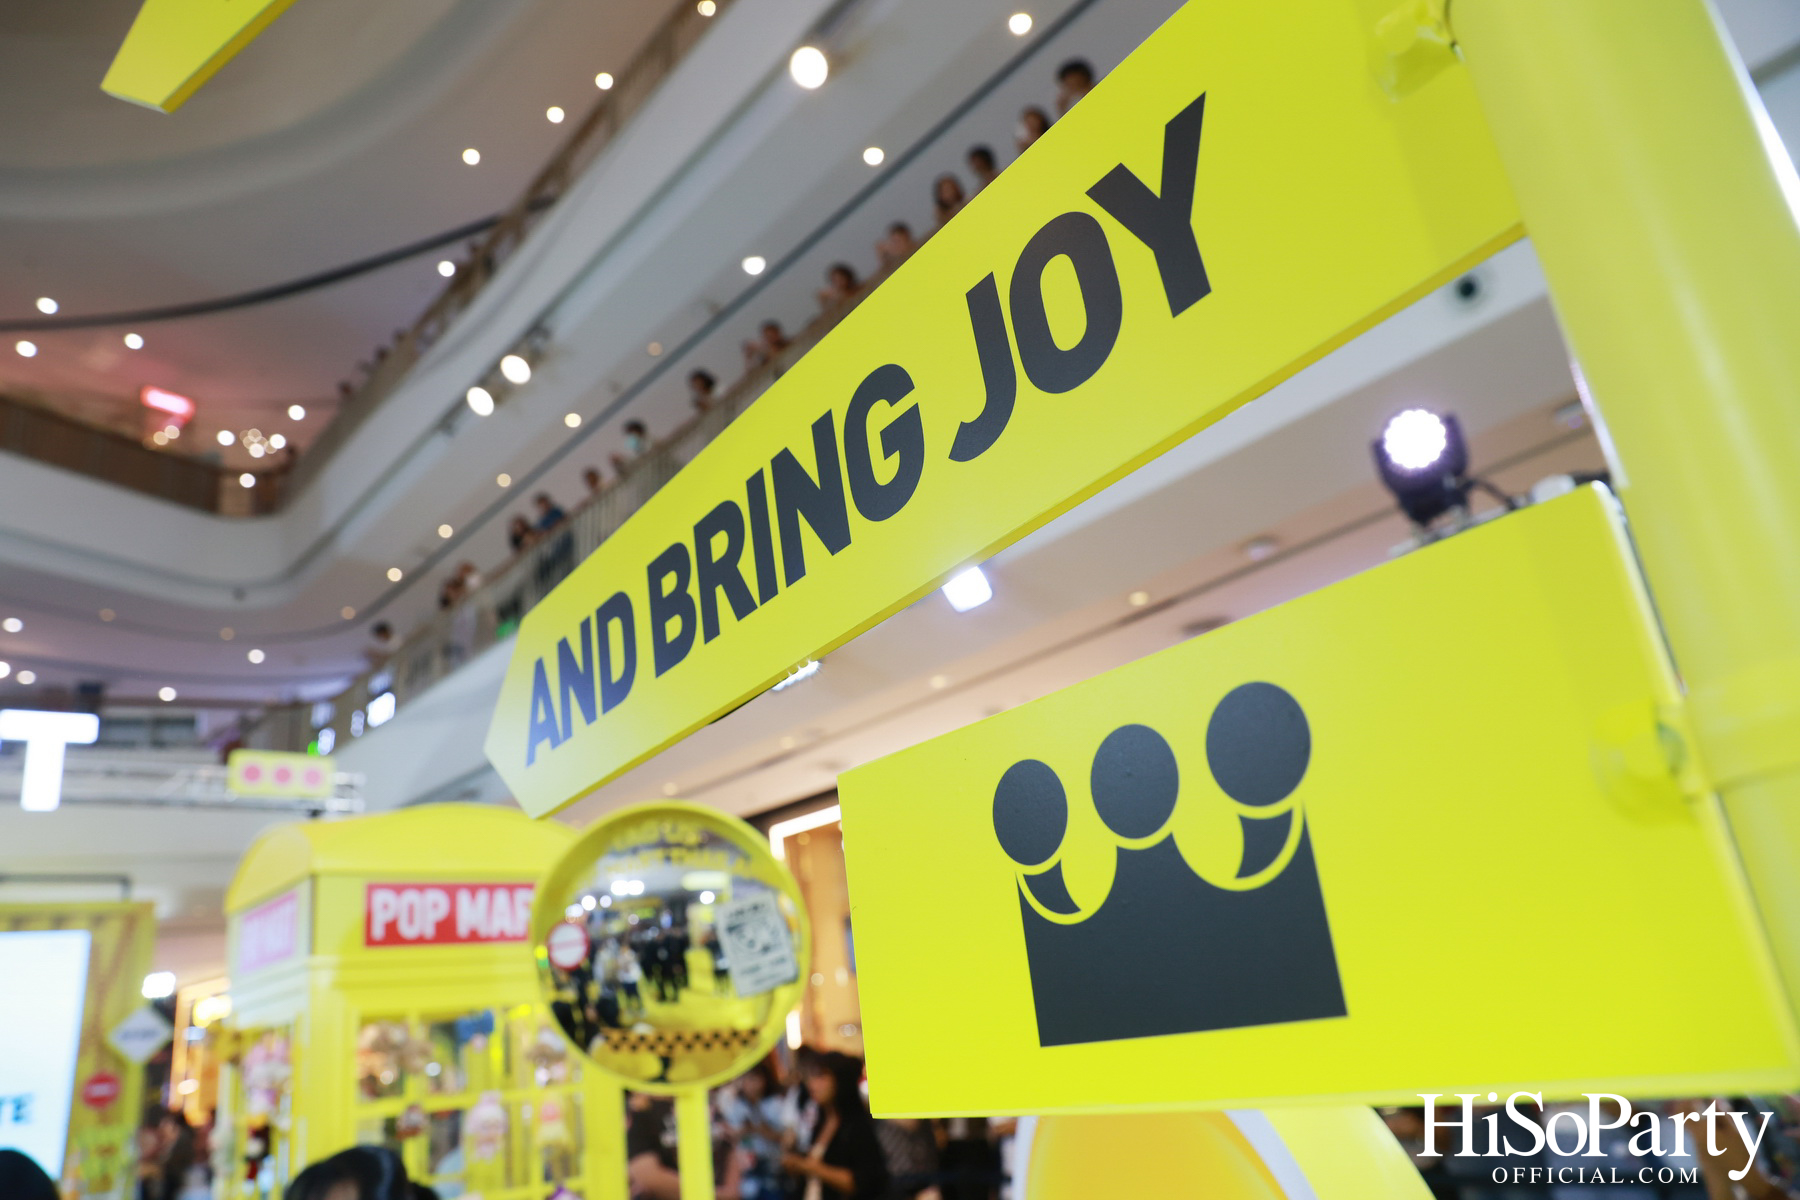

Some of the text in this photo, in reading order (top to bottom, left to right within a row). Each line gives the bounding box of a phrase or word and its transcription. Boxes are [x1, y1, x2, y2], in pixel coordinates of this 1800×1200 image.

[526, 91, 1212, 768] AND BRING JOY
[370, 887, 534, 941] POP MAR
